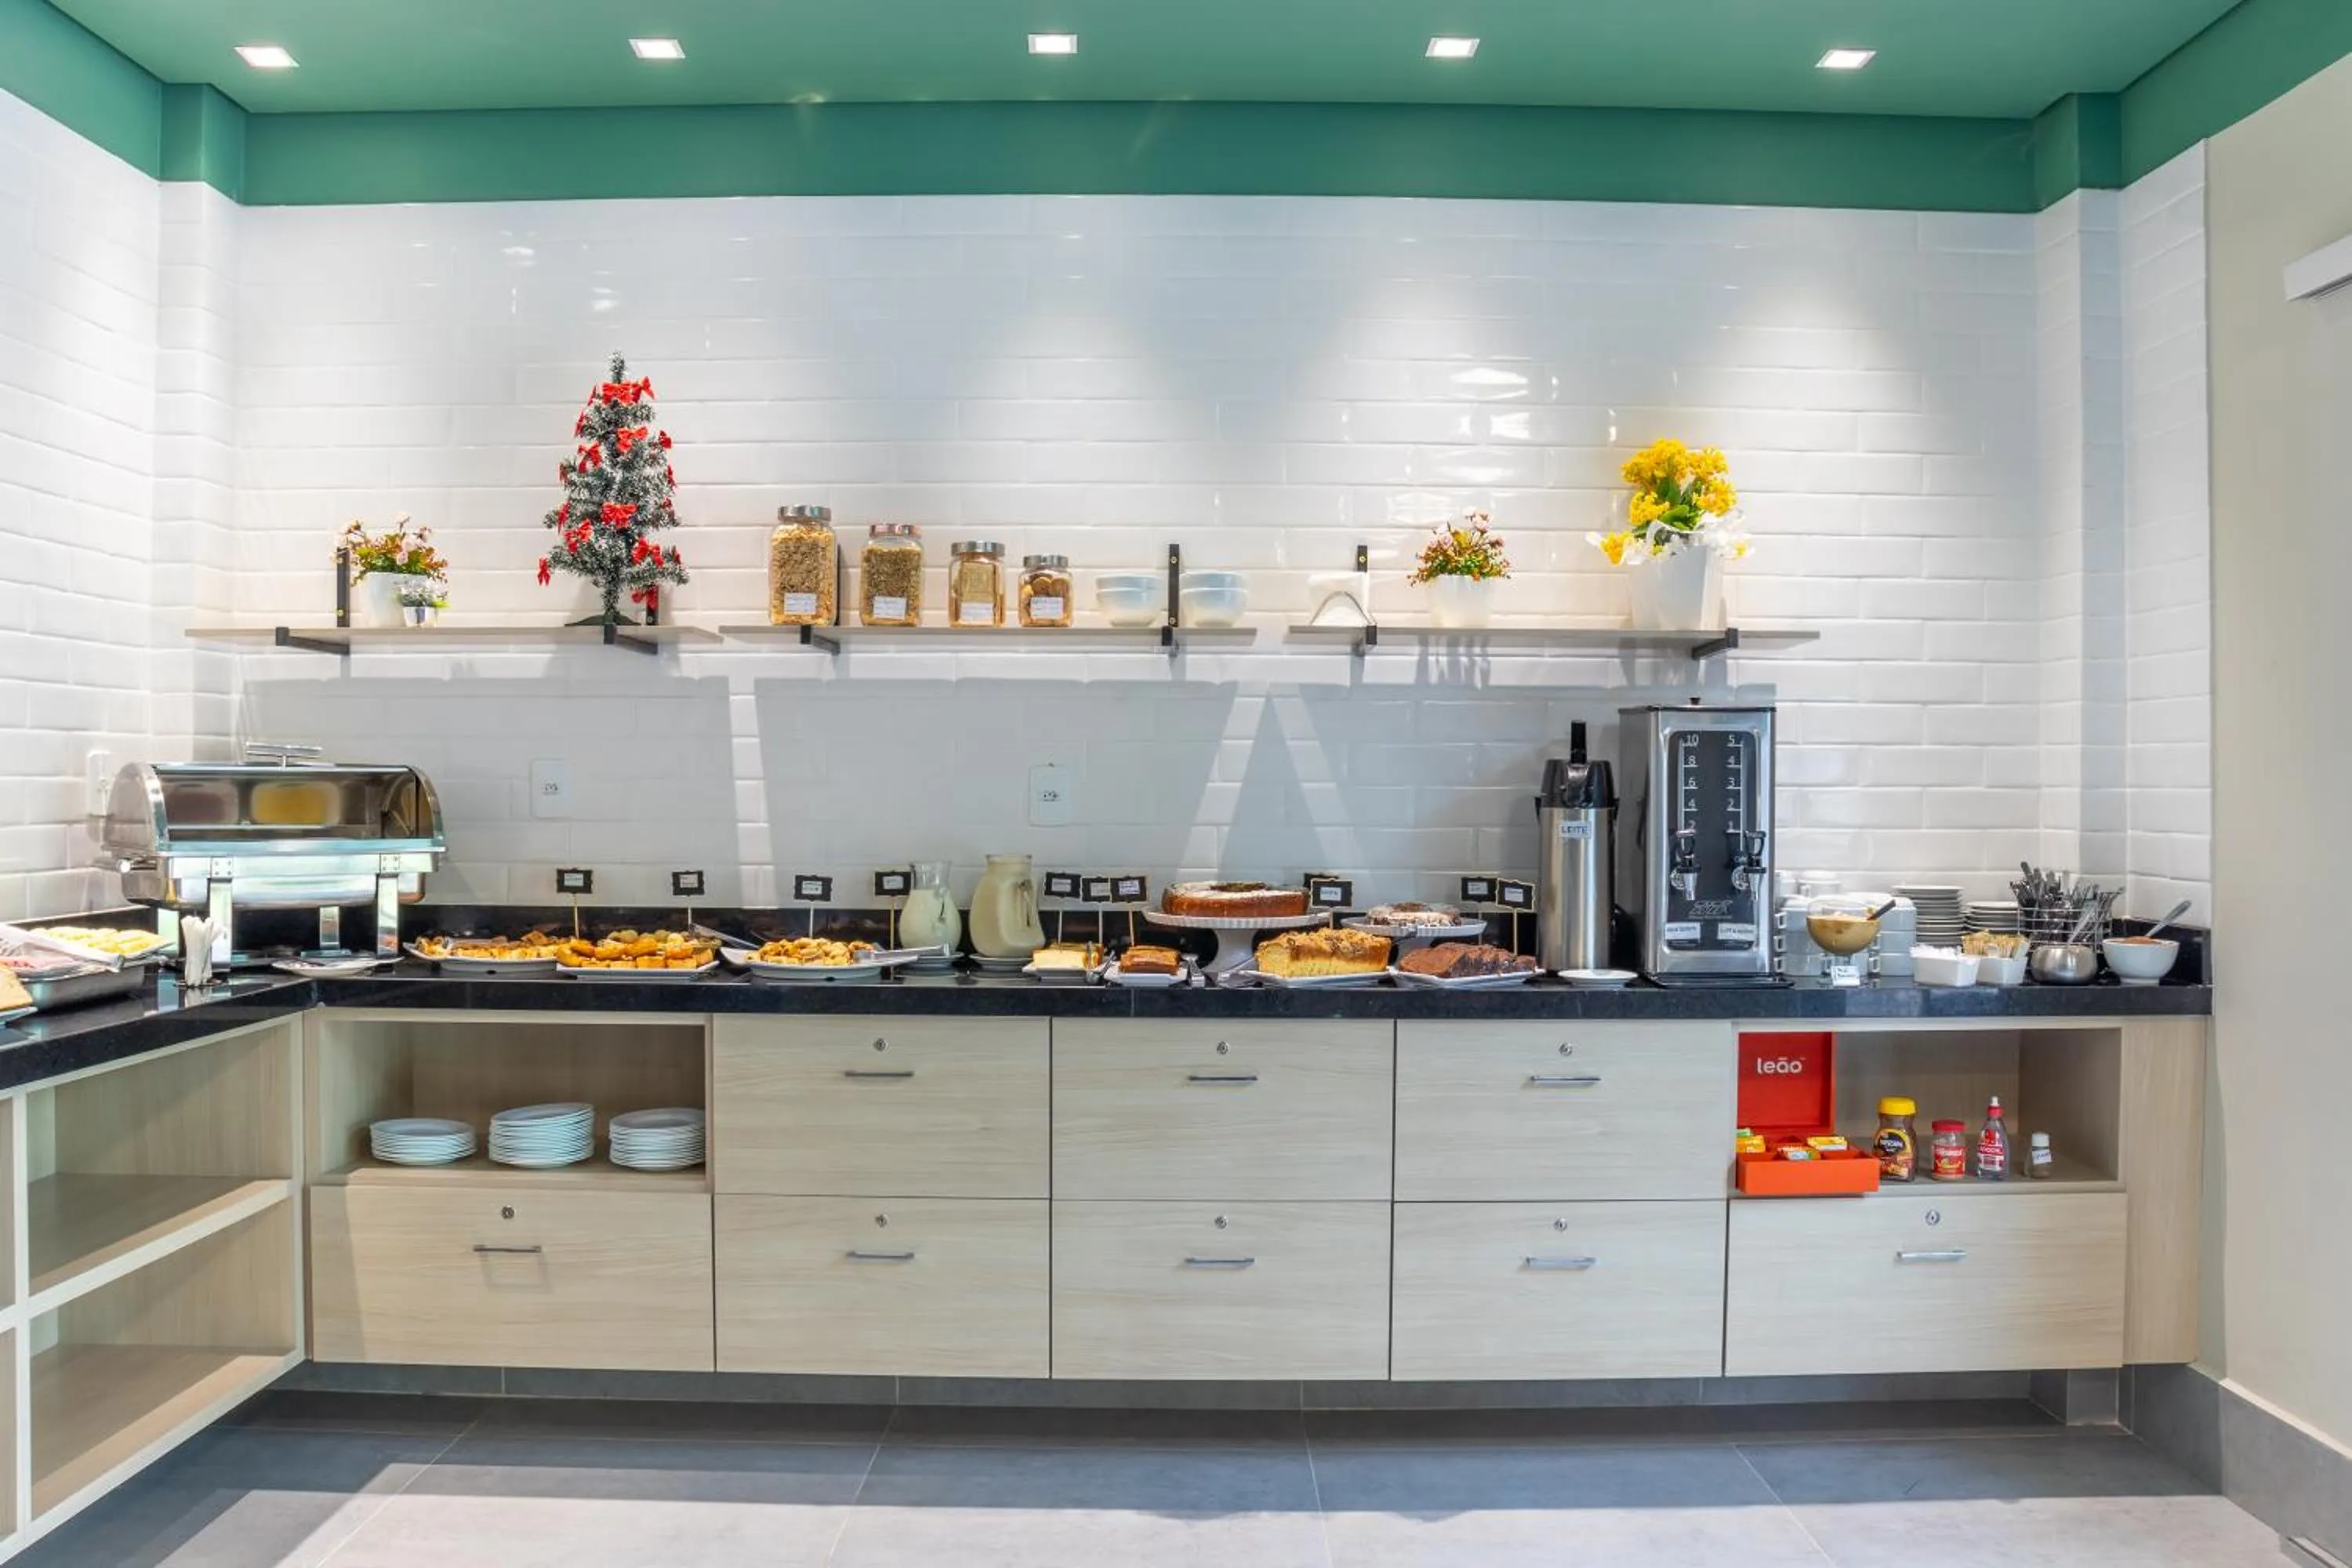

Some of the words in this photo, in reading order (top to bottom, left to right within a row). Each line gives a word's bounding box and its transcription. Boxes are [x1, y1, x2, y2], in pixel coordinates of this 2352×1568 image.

[1686, 734, 1699, 746] 10
[1729, 735, 1736, 745] 5
[1688, 755, 1696, 765] 8
[1727, 756, 1735, 765] 4
[1688, 778, 1696, 787] 6
[1728, 778, 1735, 787] 3
[1688, 798, 1696, 808] 4
[1727, 798, 1734, 808] 2
[1757, 1056, 1803, 1074] leão
